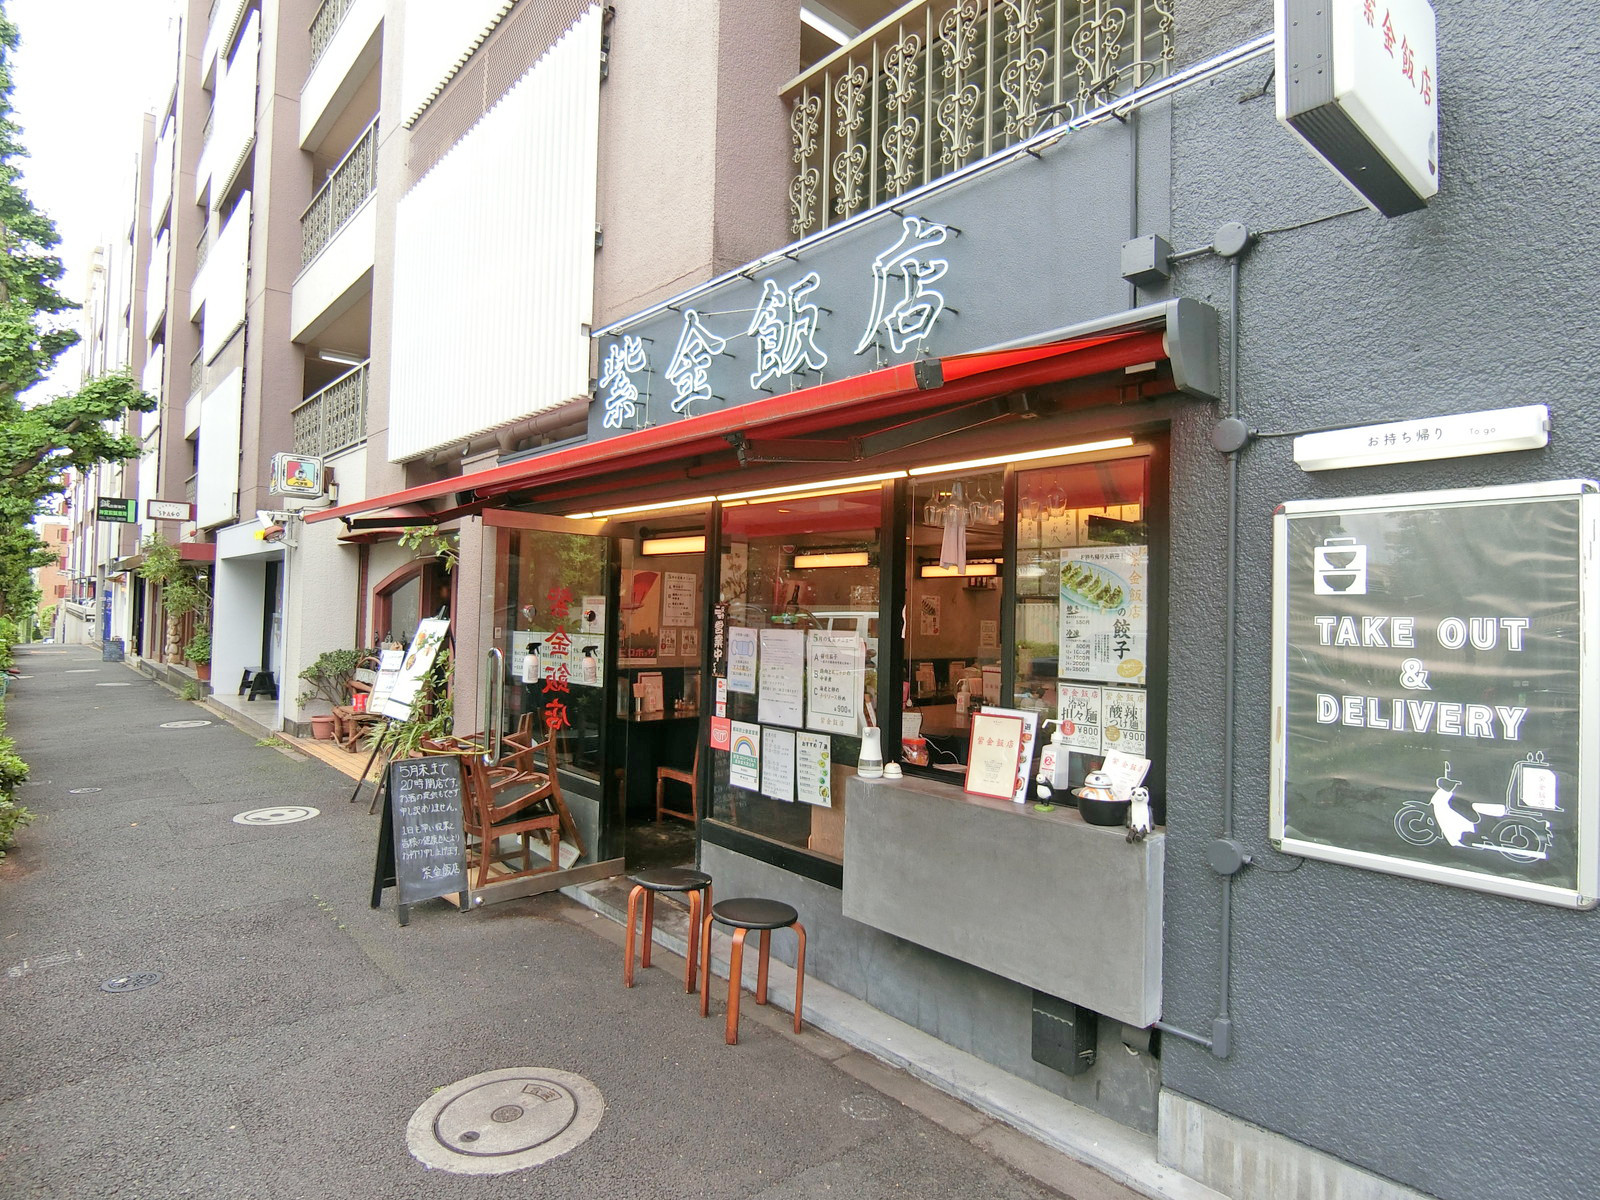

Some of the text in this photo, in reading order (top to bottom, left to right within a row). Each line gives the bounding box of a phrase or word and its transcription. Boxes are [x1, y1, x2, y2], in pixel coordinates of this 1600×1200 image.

[600, 215, 948, 429] 紫金飯店
[1368, 428, 1443, 447] お持ち帰り
[1470, 427, 1496, 436] To go
[1314, 615, 1531, 653] TAKE OUT
[813, 653, 819, 661] A
[1399, 658, 1432, 692] &
[813, 687, 819, 695] C
[1061, 687, 1099, 699] 紫金飯店
[1061, 706, 1098, 725] 担々麺
[1109, 704, 1138, 721] 酸辣
[1316, 694, 1528, 742] DELIVERY
[1077, 726, 1099, 736] ¥800
[1123, 731, 1145, 742] ¥900
[977, 736, 1015, 749] 紫金飯店
[399, 763, 449, 778] 5月末まで
